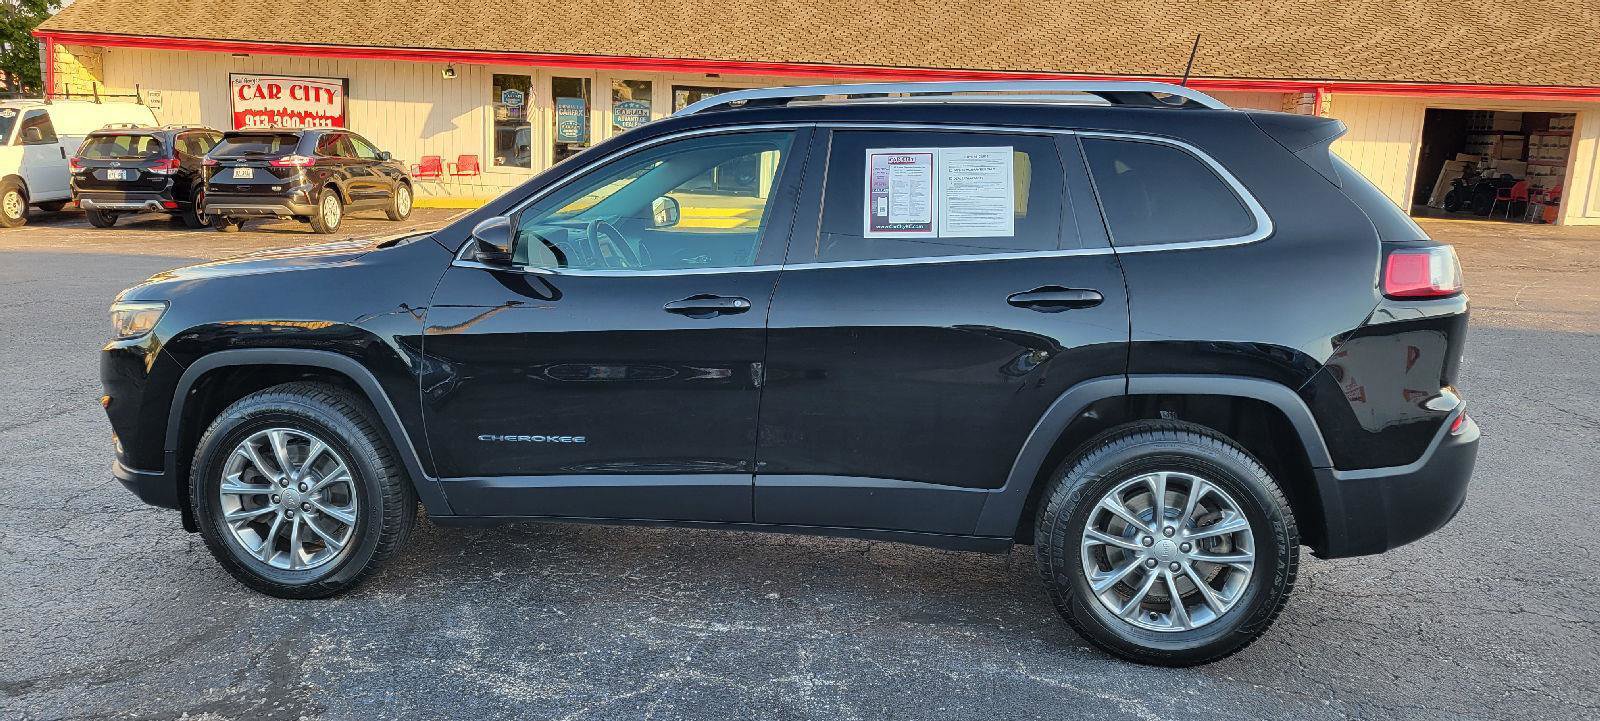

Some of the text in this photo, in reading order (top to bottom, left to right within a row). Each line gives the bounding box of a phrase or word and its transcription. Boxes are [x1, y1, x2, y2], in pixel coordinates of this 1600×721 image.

[238, 83, 338, 105] CAR CITY
[477, 434, 586, 443] CHEROKEE
